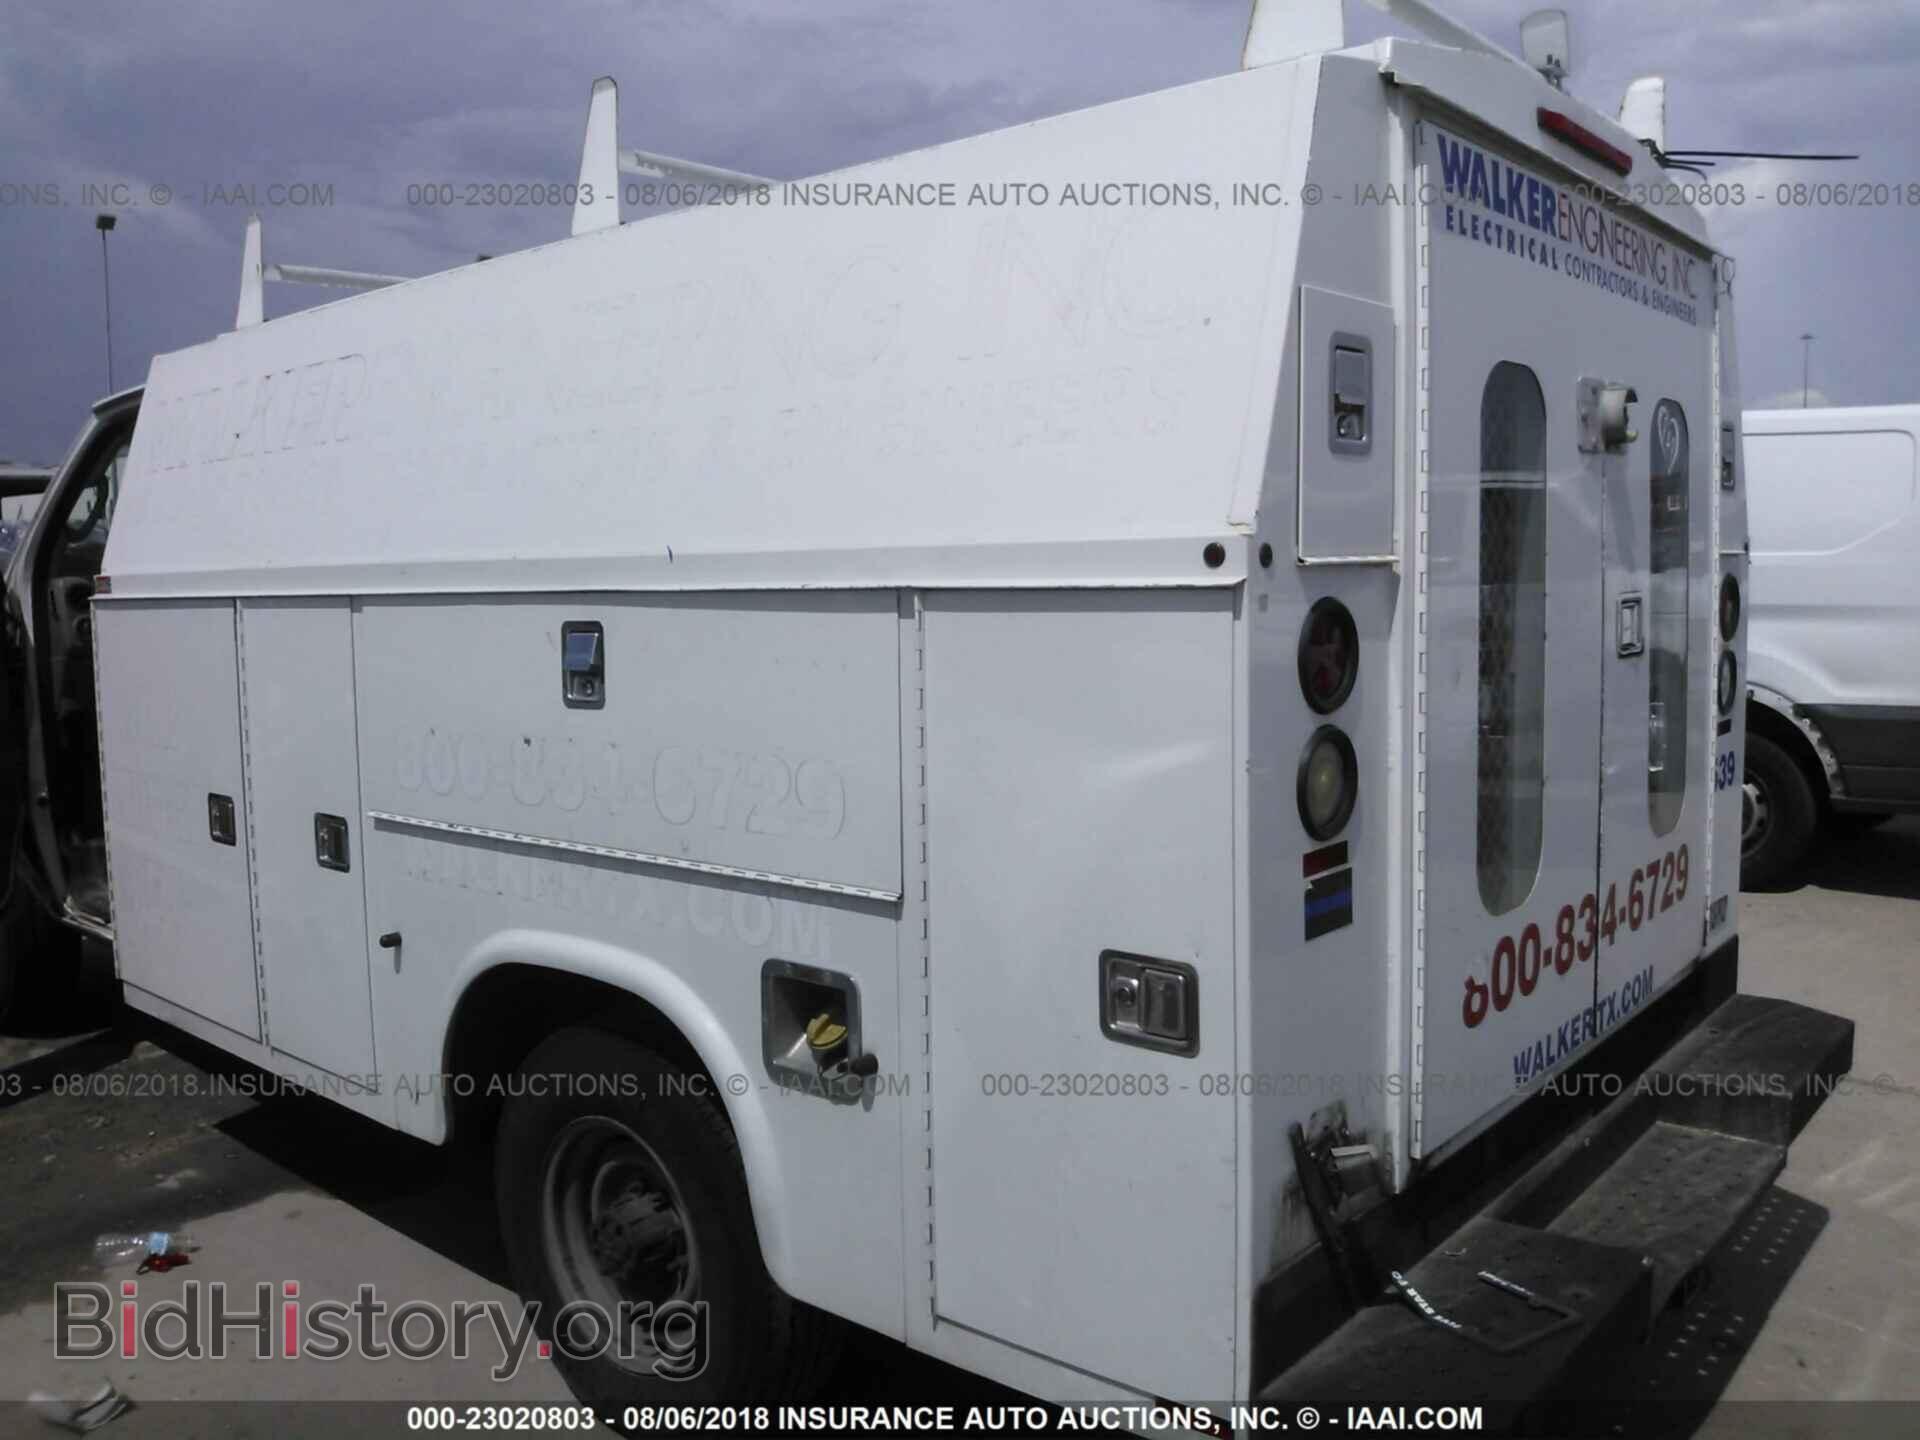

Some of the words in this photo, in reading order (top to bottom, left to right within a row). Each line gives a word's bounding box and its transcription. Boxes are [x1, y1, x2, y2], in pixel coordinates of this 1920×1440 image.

[1437, 133, 1557, 238] WALKER
[1446, 205, 1559, 271] ELECTRICAL
[1564, 253, 1638, 302] CONTRACTORS
[1513, 964, 1654, 1080] WALKERTX.COM
